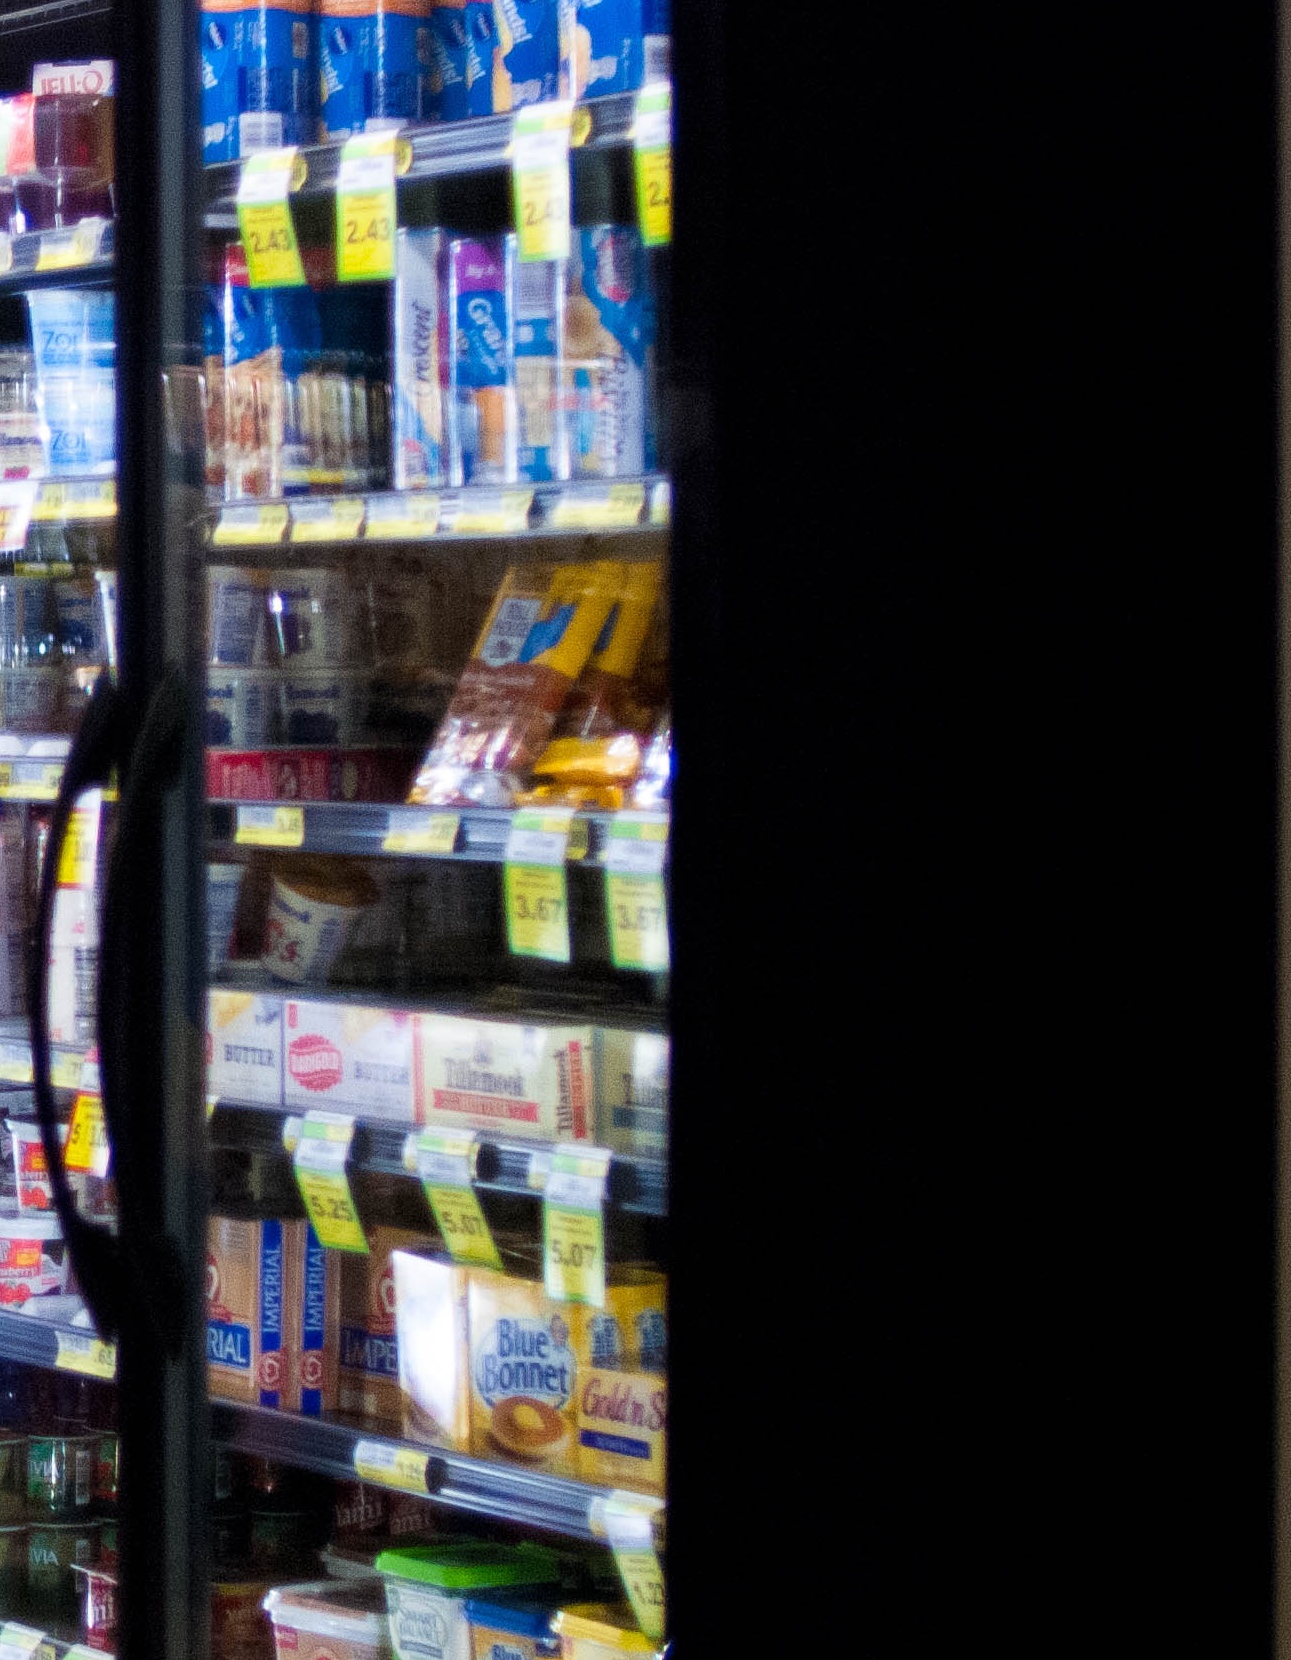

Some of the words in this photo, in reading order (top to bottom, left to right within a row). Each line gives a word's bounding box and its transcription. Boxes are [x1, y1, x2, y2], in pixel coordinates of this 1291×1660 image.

[39, 69, 104, 95] JELL-O
[249, 229, 291, 253] 2.43
[345, 217, 390, 244] 2.43
[515, 894, 565, 925] 3.67
[223, 1043, 276, 1068] BUTTER
[442, 1057, 524, 1098] Tillamook
[551, 1238, 597, 1268] 5.07
[262, 1244, 282, 1333] IMPERIAL
[206, 1326, 247, 1365] RIAL
[341, 1329, 397, 1376] IMPE
[497, 1316, 550, 1358] Blue
[483, 1354, 567, 1394] Bonnet
